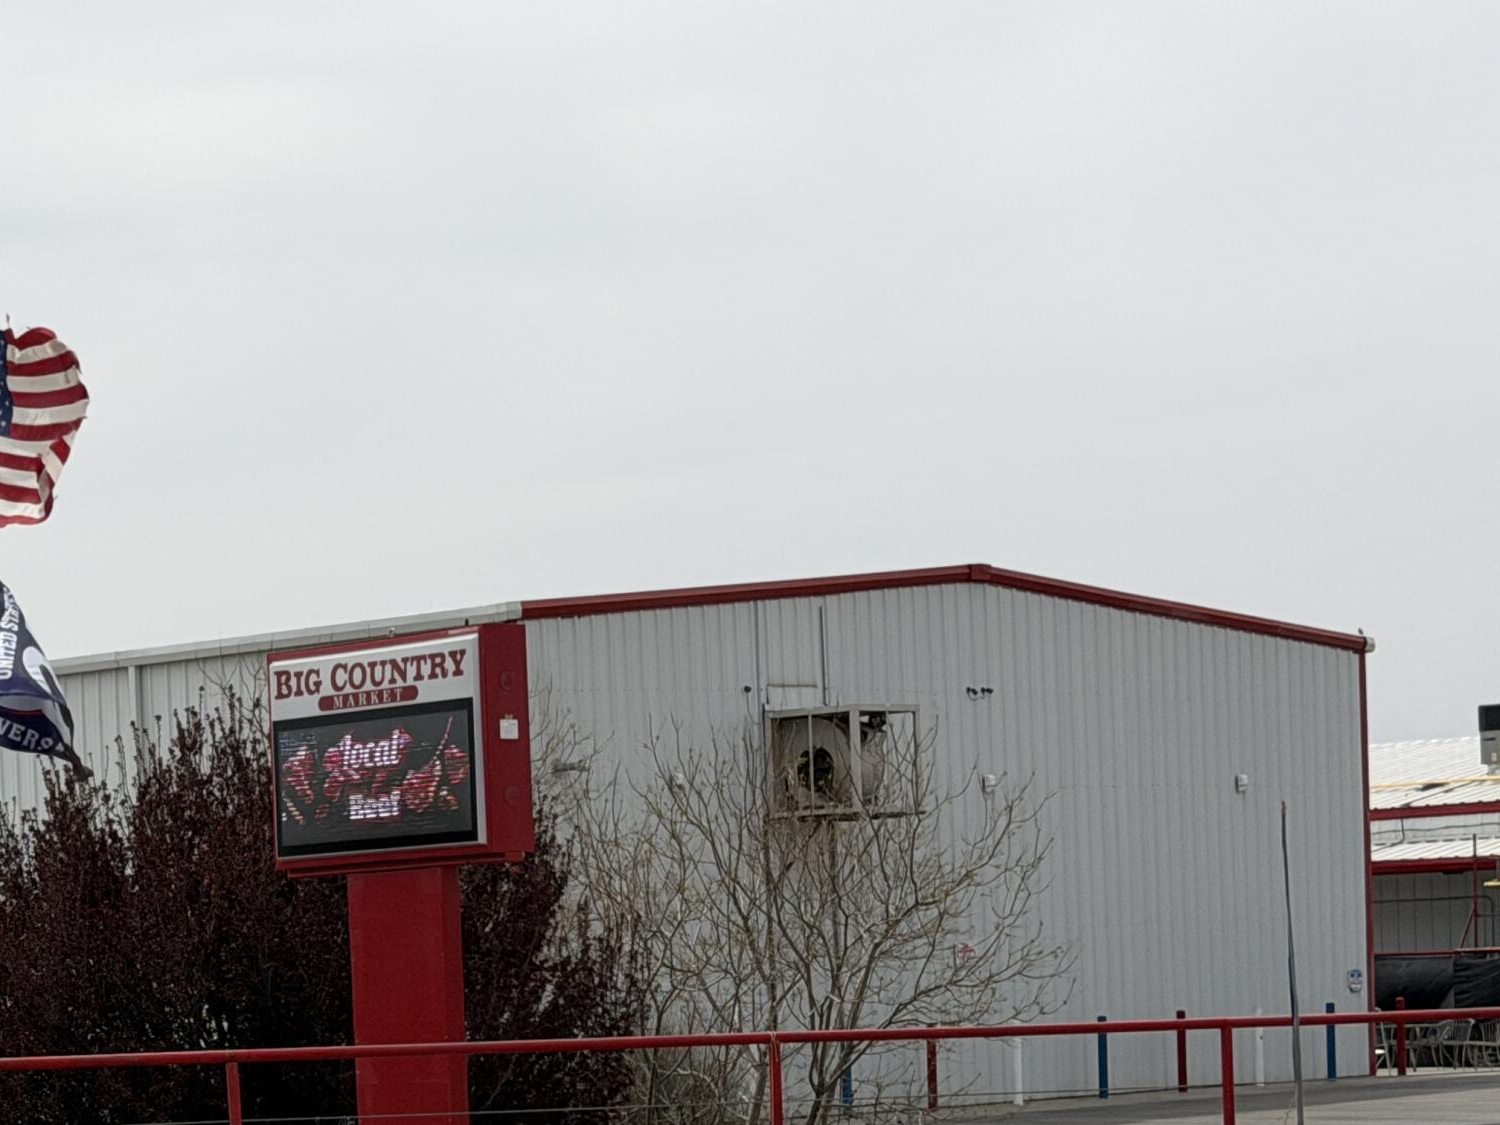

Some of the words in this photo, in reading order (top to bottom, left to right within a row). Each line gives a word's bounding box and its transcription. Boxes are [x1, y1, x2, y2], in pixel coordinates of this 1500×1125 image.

[274, 668, 322, 700] BIG
[330, 649, 467, 693] COUNTRY
[333, 688, 403, 709] MARKET
